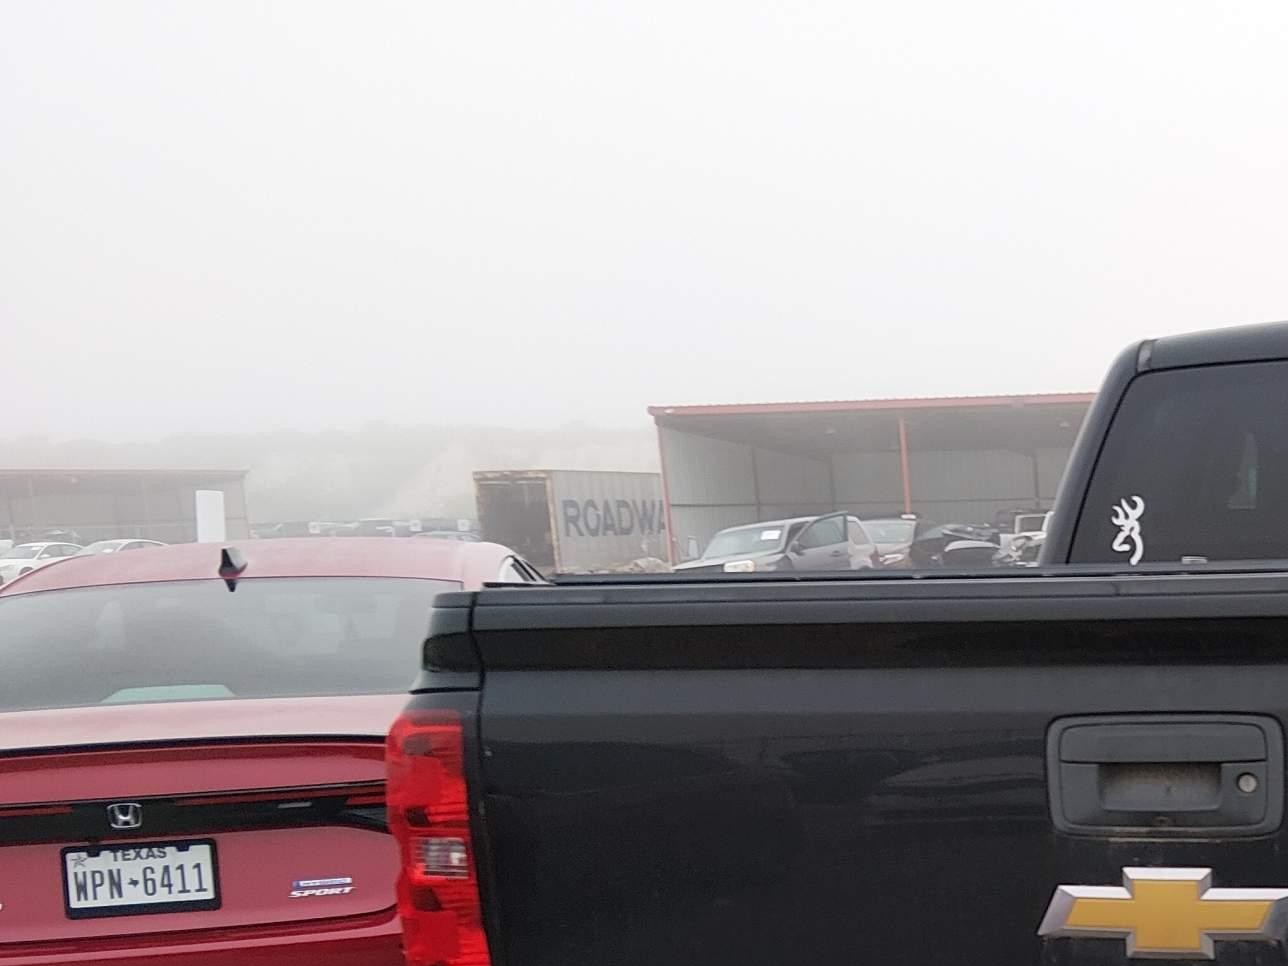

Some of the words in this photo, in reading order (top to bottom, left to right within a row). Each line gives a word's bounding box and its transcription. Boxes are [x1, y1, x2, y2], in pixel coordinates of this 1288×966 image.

[109, 847, 168, 862] TEXAS
[73, 868, 123, 902] WPN
[142, 862, 208, 897] 6411
[288, 886, 356, 898] SPORT
